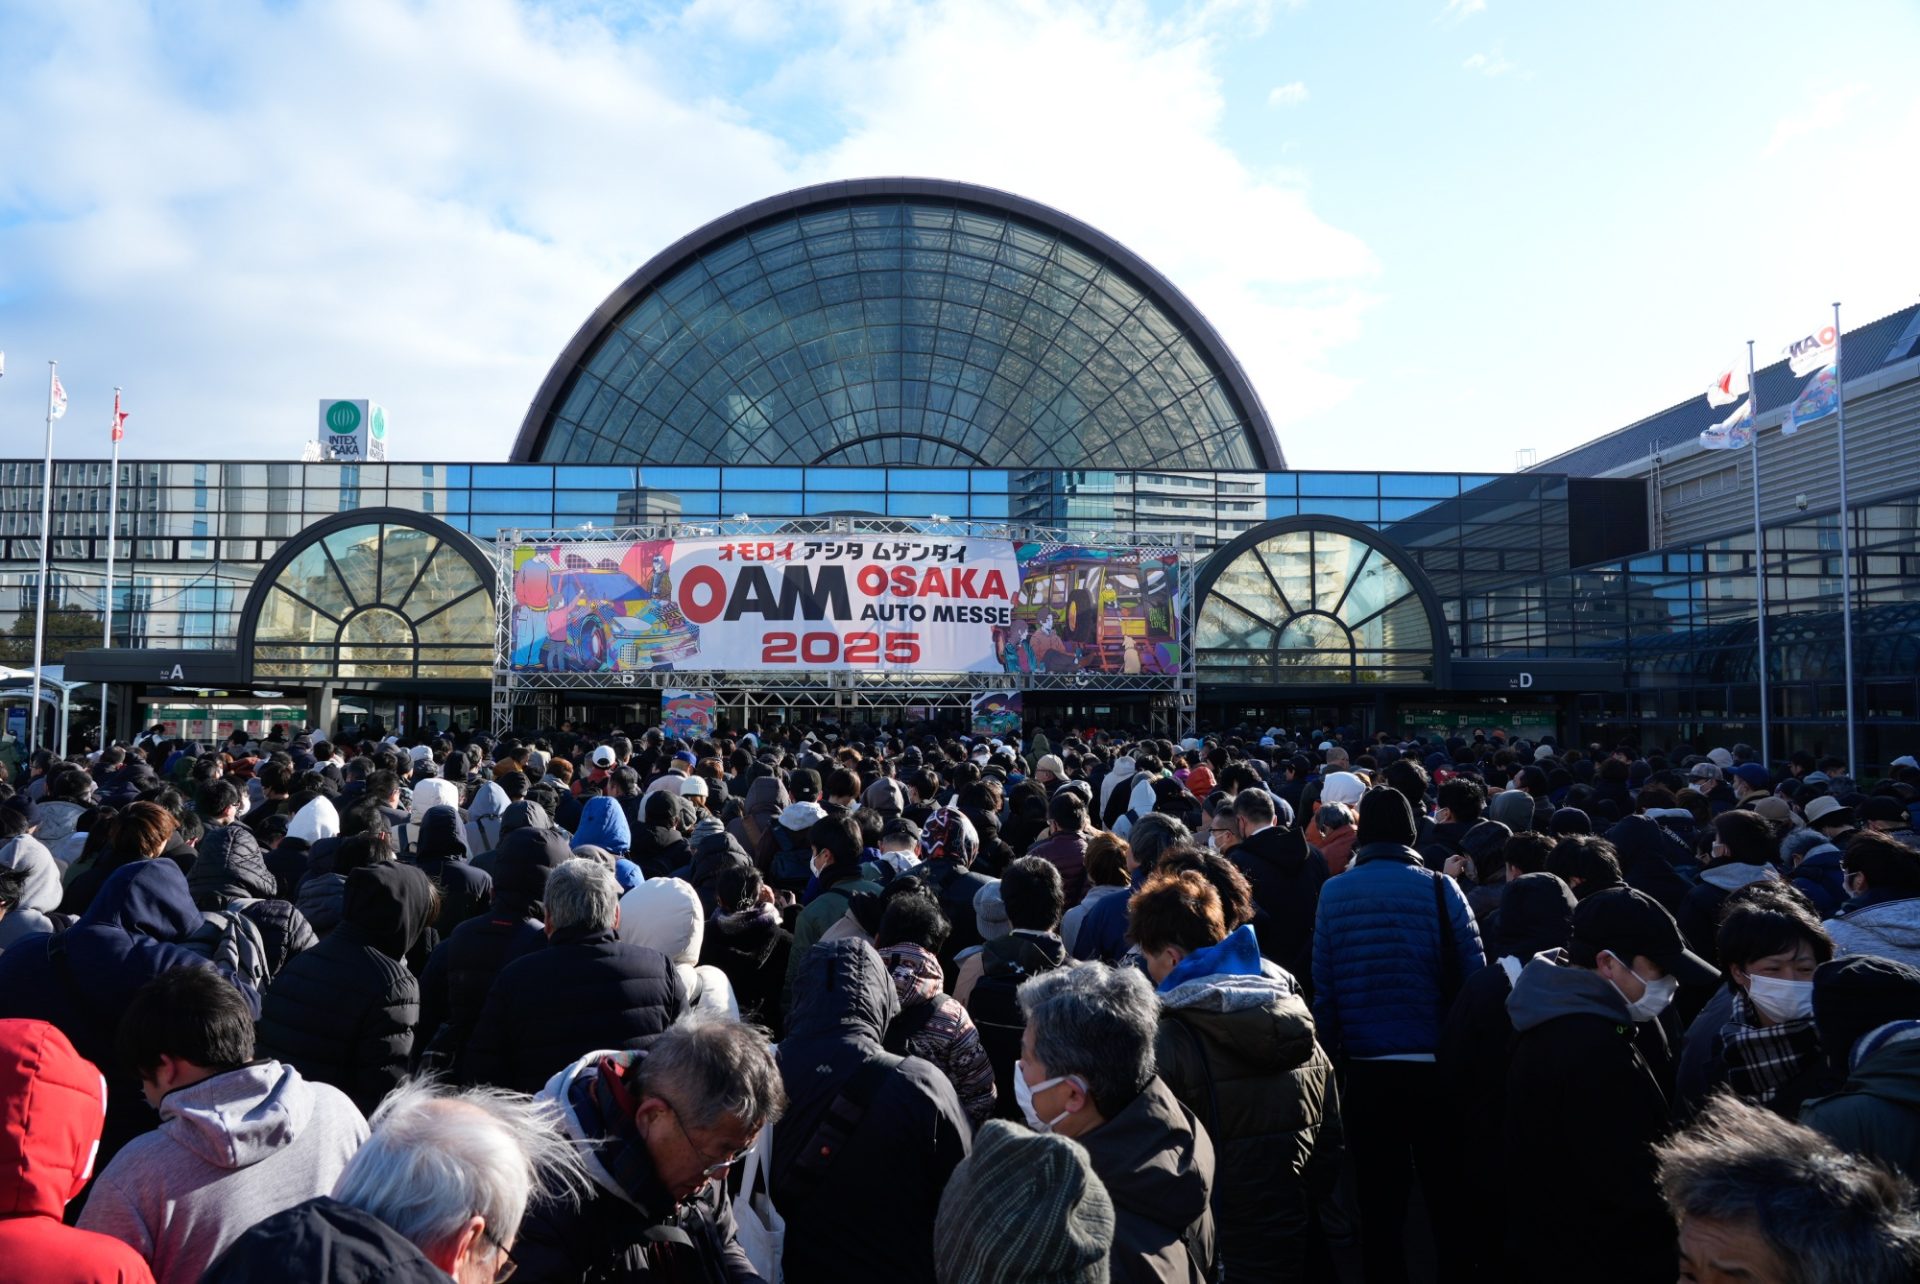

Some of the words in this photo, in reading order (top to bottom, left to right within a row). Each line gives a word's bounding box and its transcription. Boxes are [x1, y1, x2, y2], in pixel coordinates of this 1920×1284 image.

[329, 435, 357, 445] INTEX
[331, 445, 360, 455] SAKA
[718, 542, 794, 561] オモロイ
[804, 542, 864, 560] アシタ
[872, 542, 967, 563] ムゲンダイ
[857, 564, 1009, 600] OSAKA
[678, 564, 852, 624] OAM
[860, 604, 926, 622] AUTO
[932, 605, 1011, 625] MESSE
[762, 632, 921, 664] 2025
[170, 664, 184, 680] A
[1520, 673, 1533, 688] D
